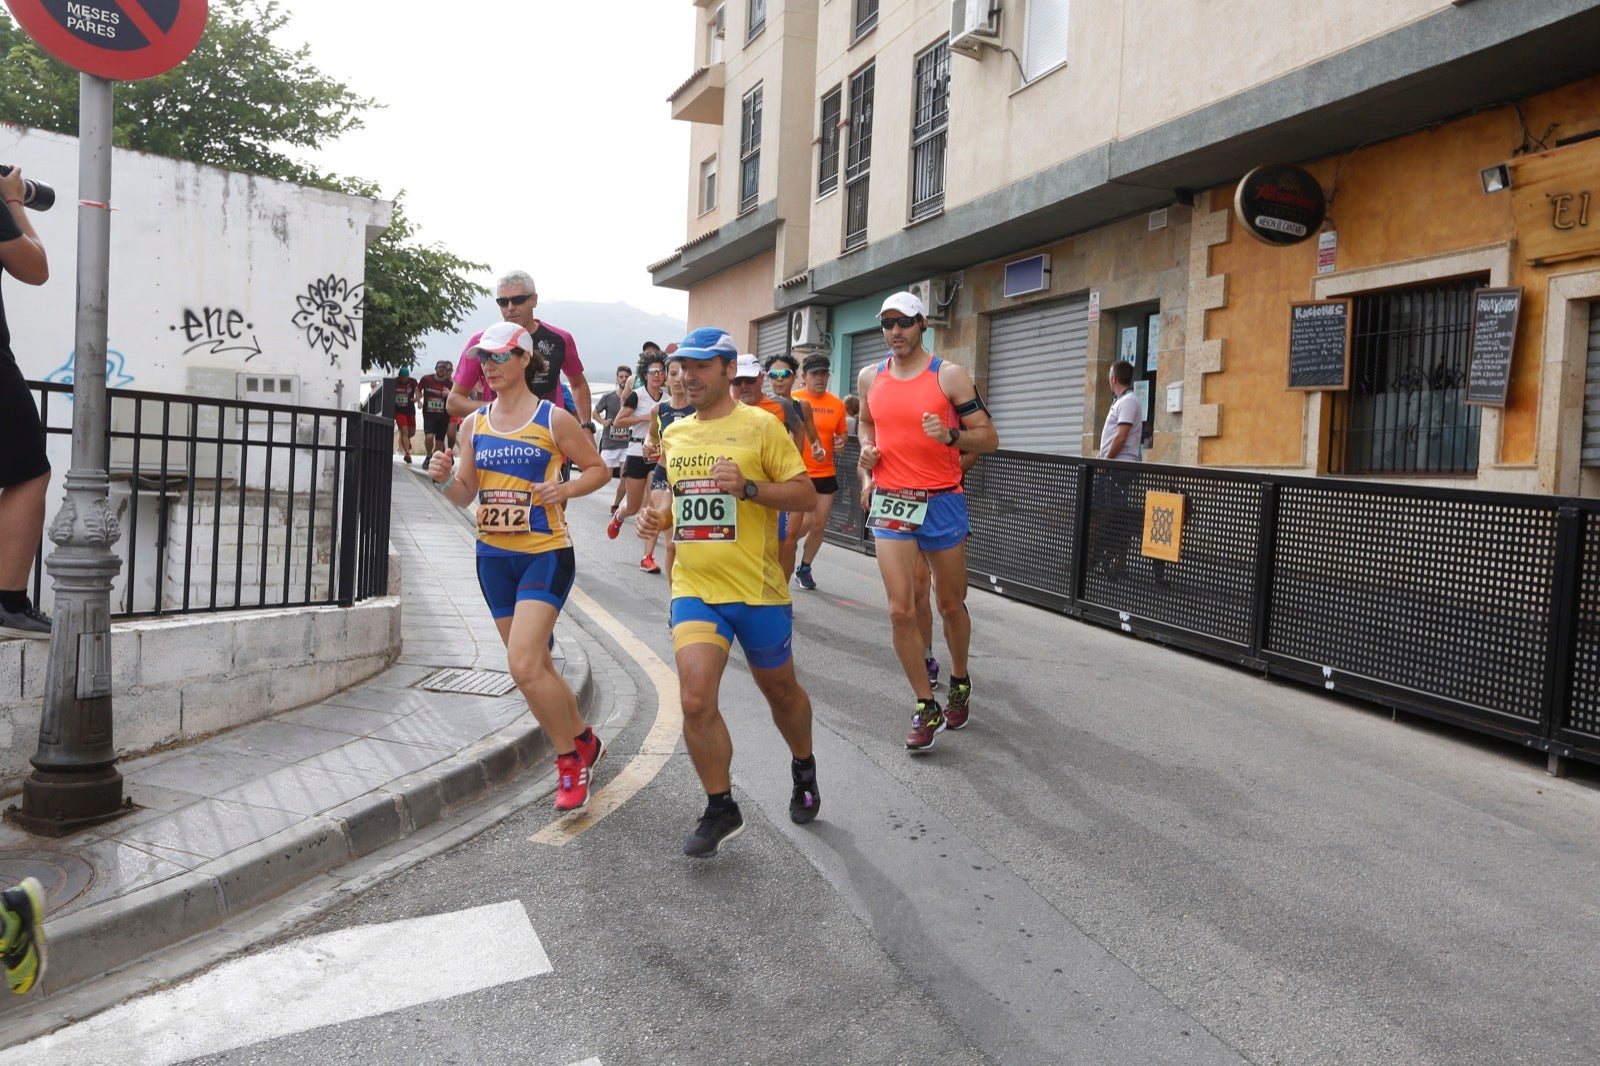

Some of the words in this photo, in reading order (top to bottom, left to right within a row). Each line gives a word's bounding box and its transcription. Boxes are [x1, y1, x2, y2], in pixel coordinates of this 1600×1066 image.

[67, 1, 120, 25] MESES
[67, 16, 116, 38] PARES
[476, 445, 541, 462] agustinos
[670, 453, 733, 470] agustin
[677, 469, 713, 477] GRANAD
[482, 508, 526, 527] 2212
[682, 498, 725, 521] 806
[880, 499, 919, 519] 567
